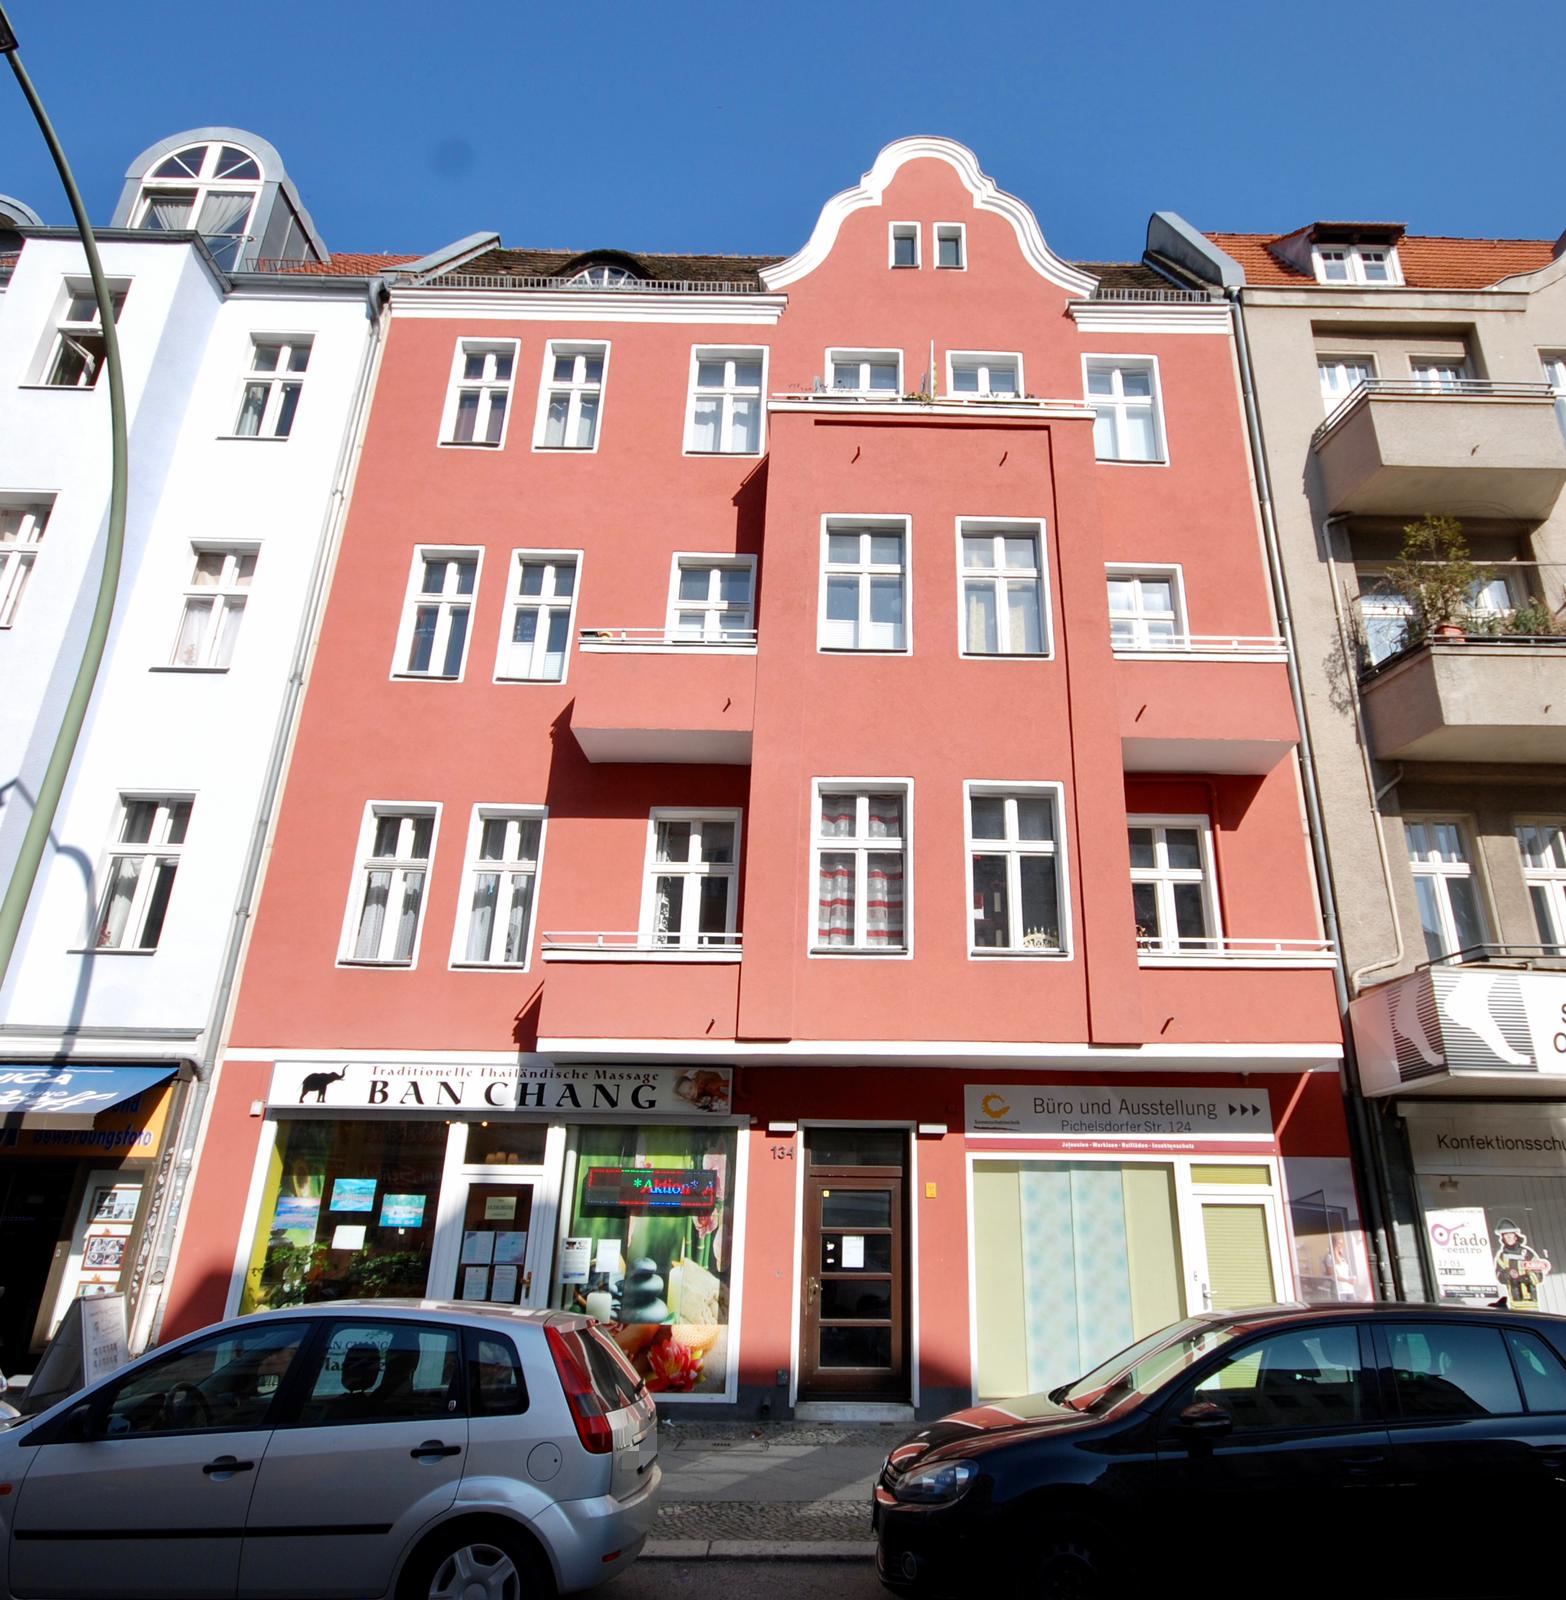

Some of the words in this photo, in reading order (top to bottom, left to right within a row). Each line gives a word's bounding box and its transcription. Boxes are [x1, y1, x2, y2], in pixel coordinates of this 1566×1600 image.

[371, 1065, 473, 1078] Traditionelle
[480, 1067, 589, 1081] Thailändische
[594, 1069, 660, 1084] Massage
[367, 1080, 465, 1106] BAN
[484, 1080, 659, 1110] CHANG
[1033, 1097, 1073, 1115] Büro
[1080, 1098, 1111, 1115] und
[1119, 1098, 1218, 1120] Ausstellung
[1061, 1120, 1142, 1132] Pichelsdorfer
[1144, 1121, 1165, 1133] Str.
[1169, 1121, 1192, 1133] 124
[770, 1145, 794, 1160] 134
[1453, 1232, 1488, 1247] fado
[1447, 1246, 1482, 1254] centro
